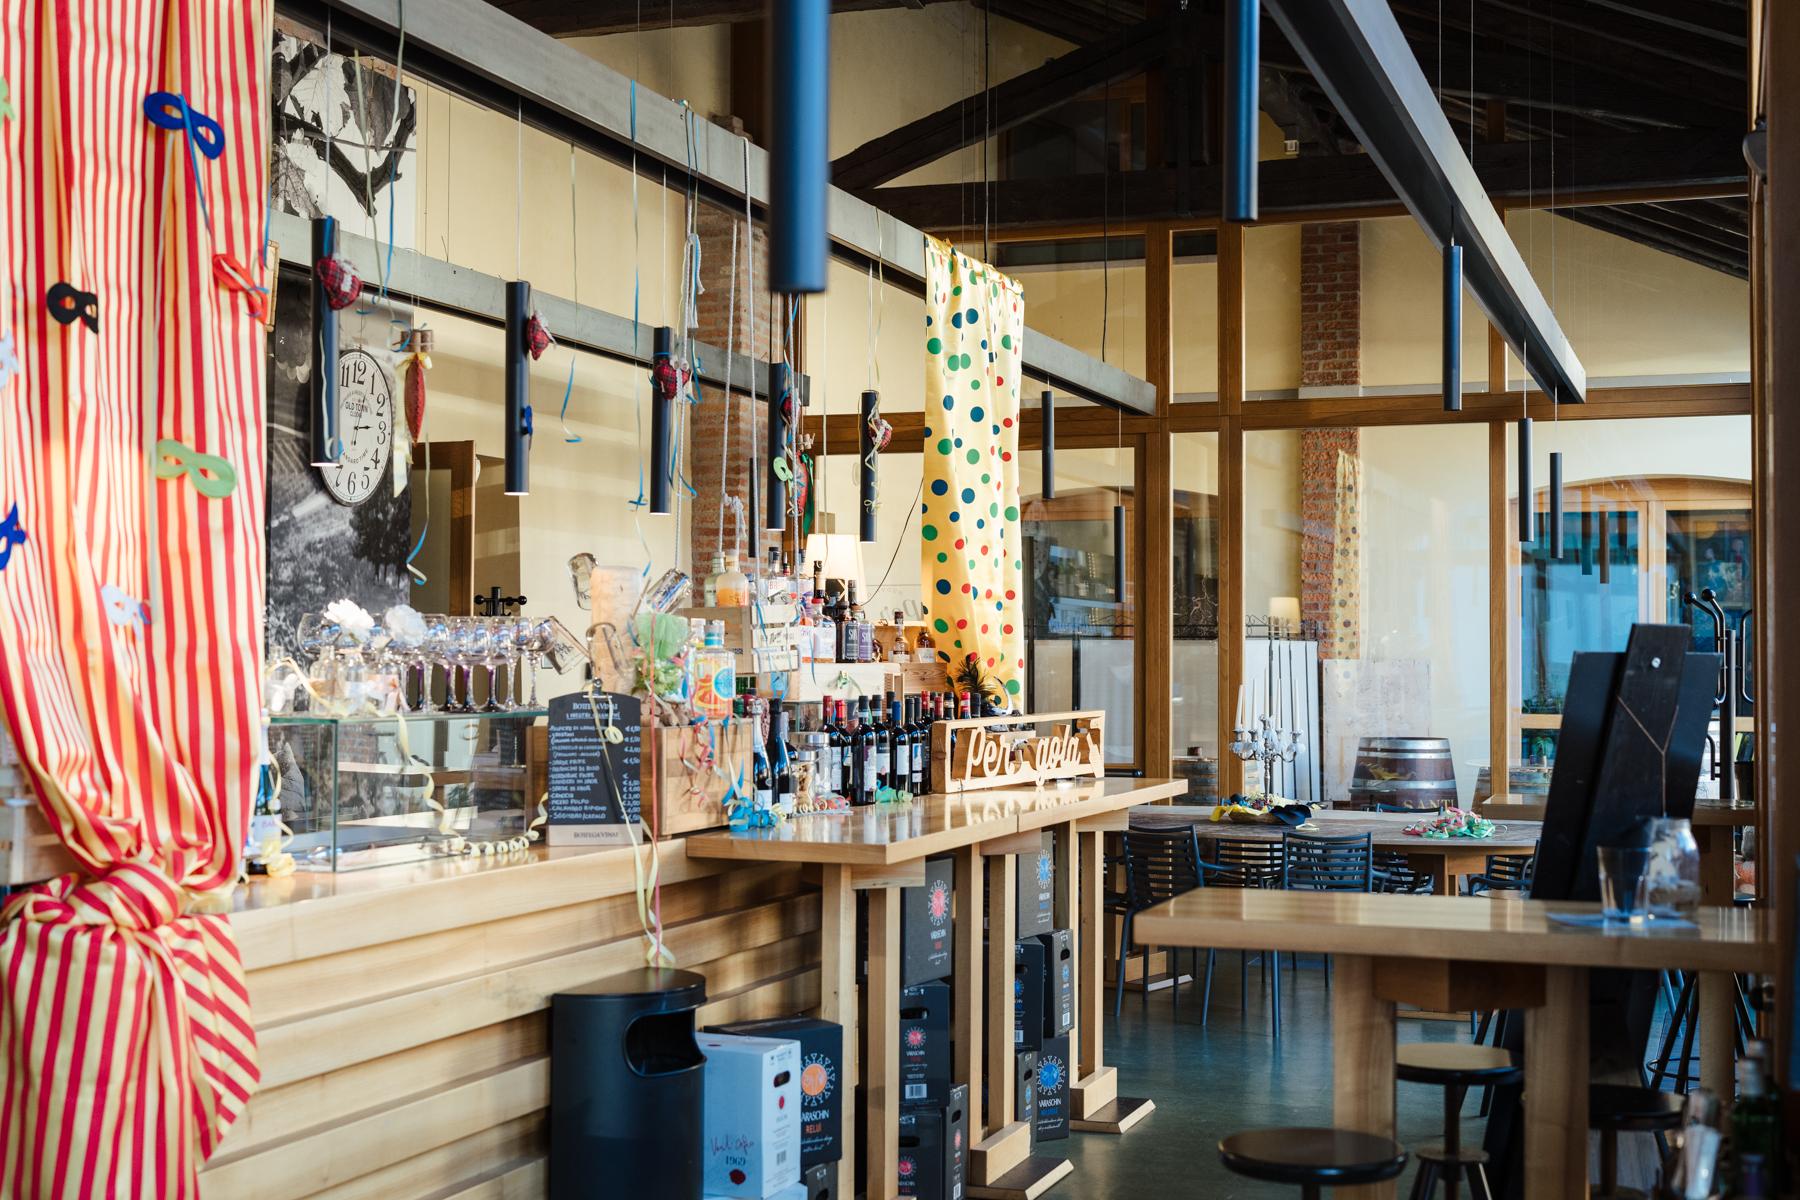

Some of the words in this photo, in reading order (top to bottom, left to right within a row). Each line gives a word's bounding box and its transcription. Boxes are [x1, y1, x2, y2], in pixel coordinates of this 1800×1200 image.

[341, 363, 350, 388] 11
[352, 360, 367, 385] 12
[370, 373, 376, 395] 1
[345, 401, 355, 411] OLD
[376, 392, 386, 417] 2
[376, 420, 387, 445] 3
[370, 447, 381, 470] 4
[336, 464, 344, 488] 7
[347, 471, 357, 496] 6
[361, 466, 370, 490] 5
[801, 1109, 830, 1122] ARASCHIN
